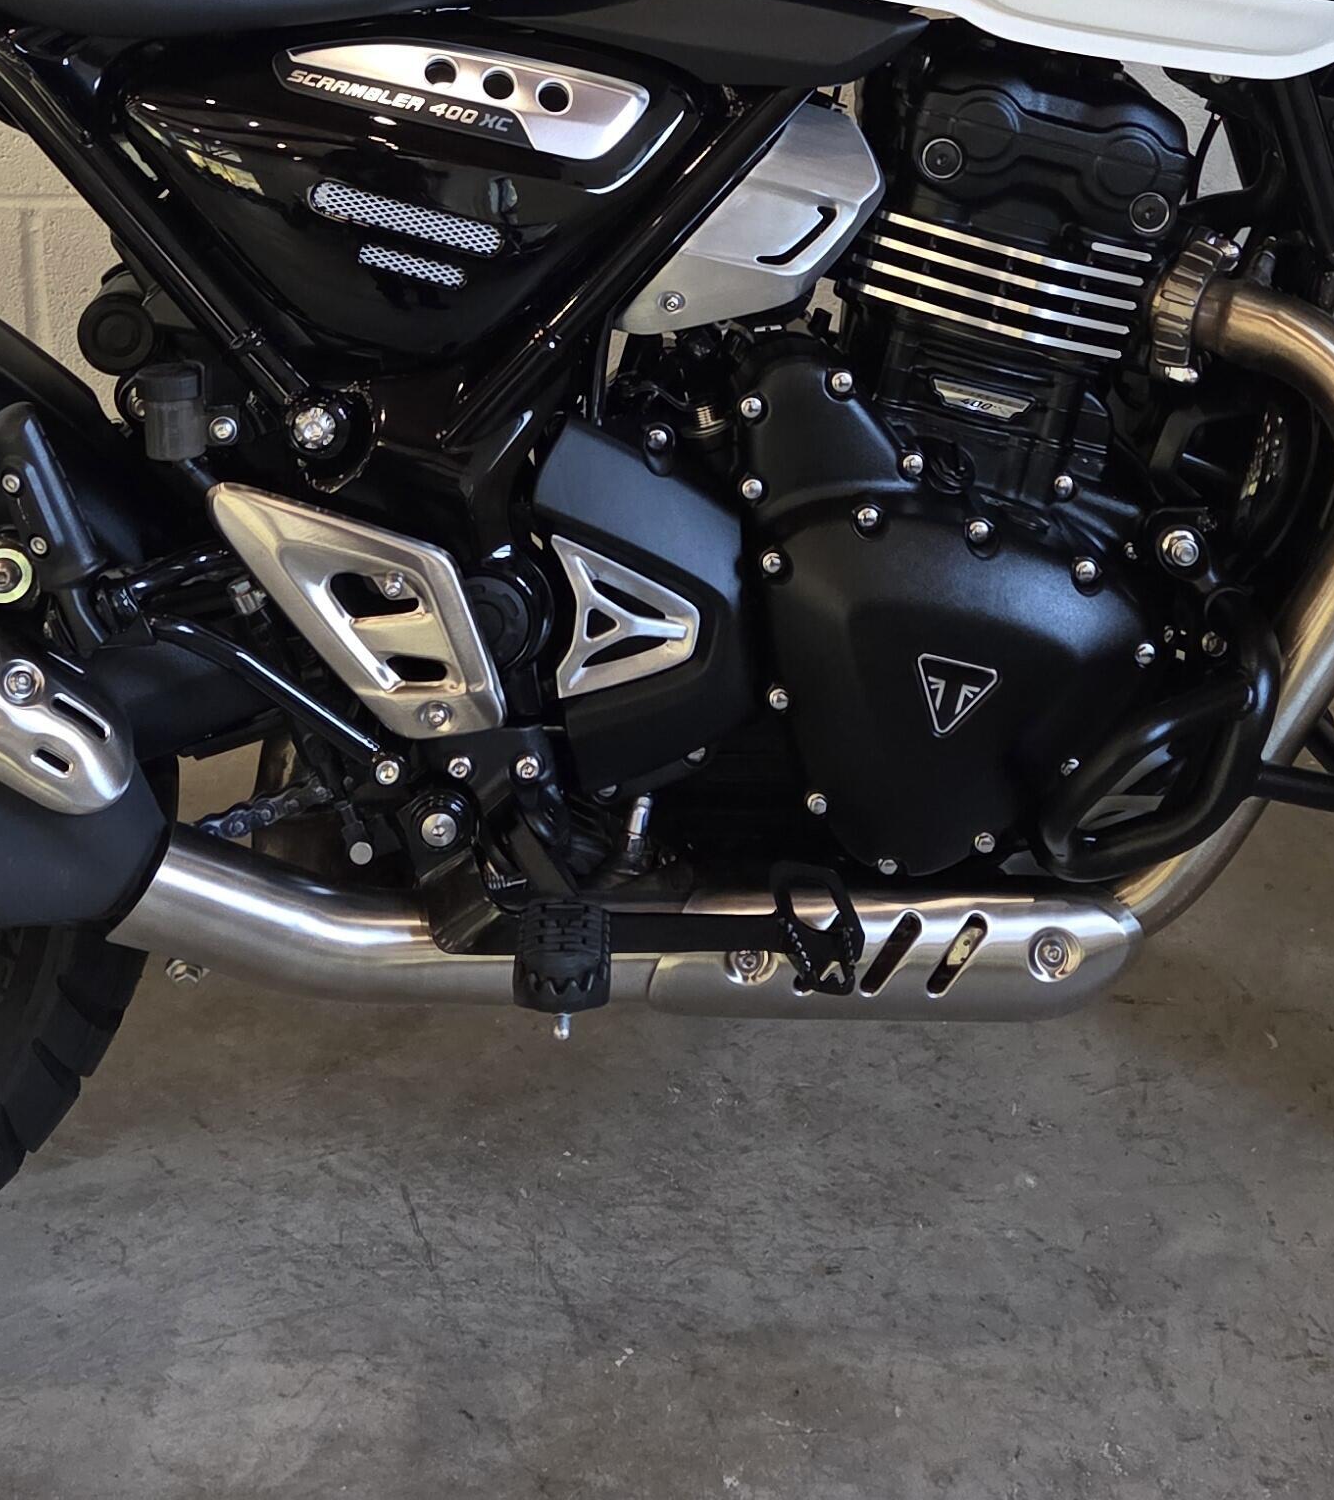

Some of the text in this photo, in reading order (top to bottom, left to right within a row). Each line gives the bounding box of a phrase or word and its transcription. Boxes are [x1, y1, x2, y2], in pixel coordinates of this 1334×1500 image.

[287, 70, 514, 133] SCRAMBLER 400 XC
